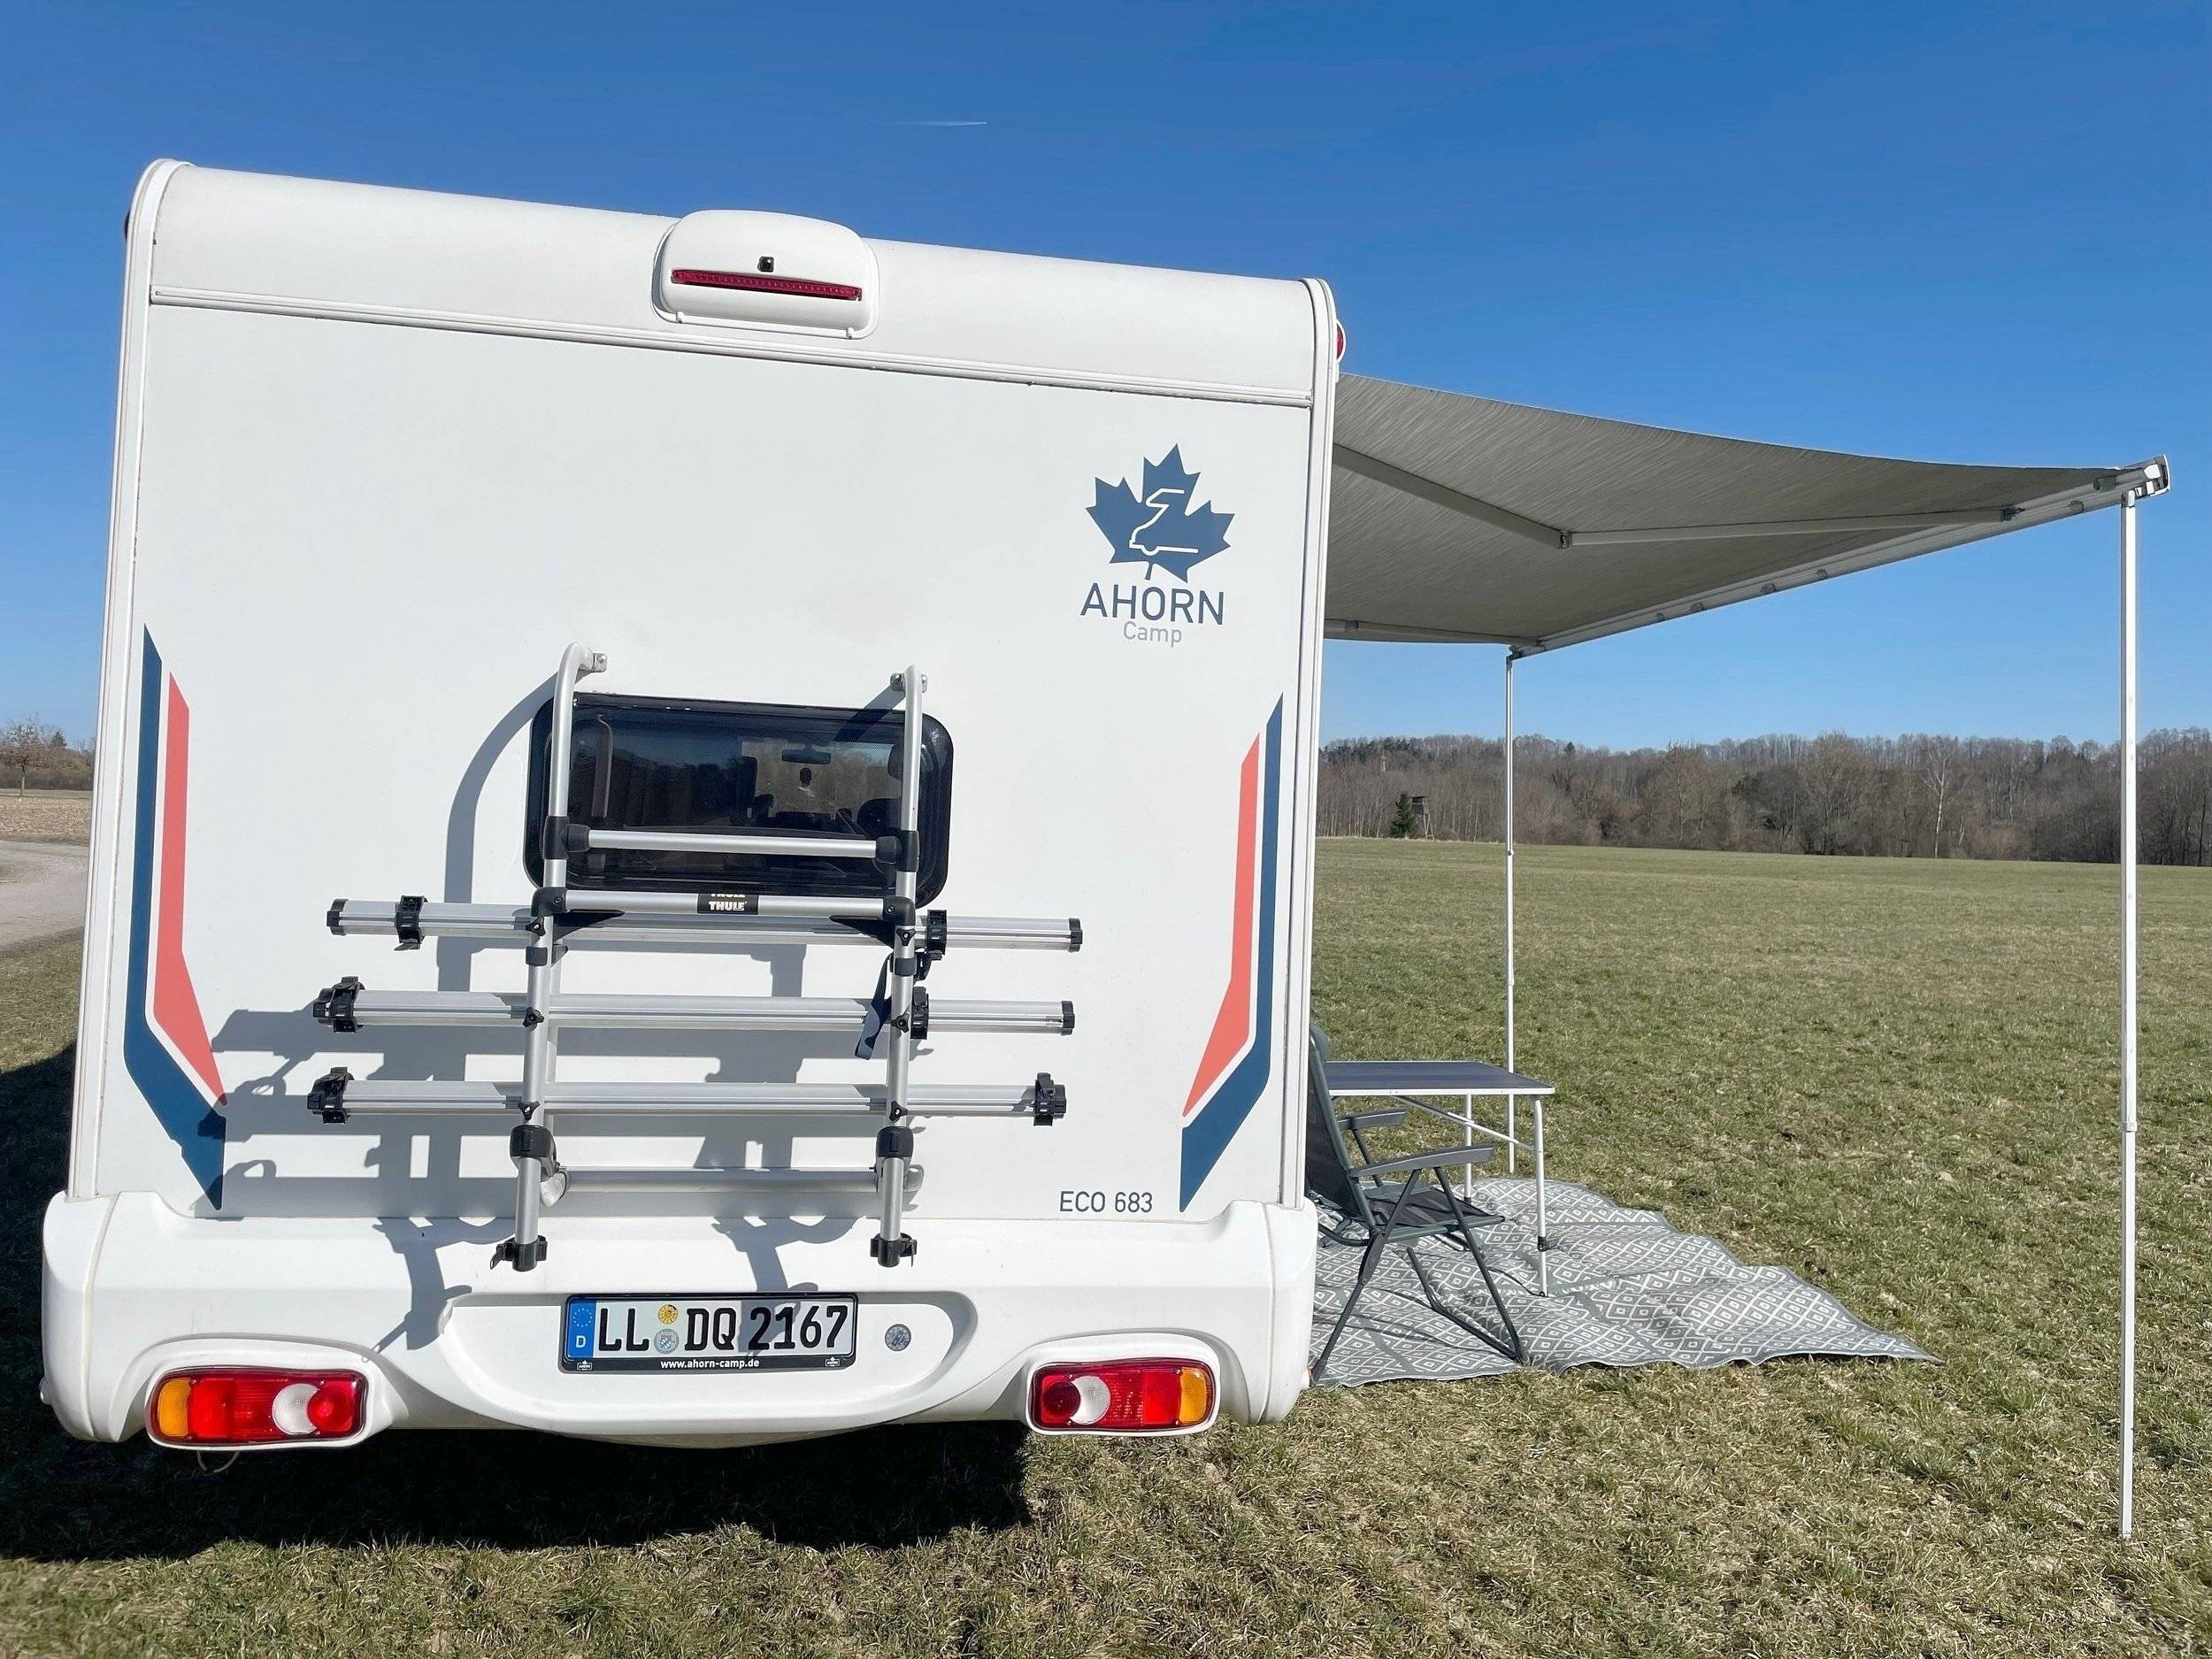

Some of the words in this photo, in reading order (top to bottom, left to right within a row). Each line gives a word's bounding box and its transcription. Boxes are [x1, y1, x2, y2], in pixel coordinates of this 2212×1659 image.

[1080, 582, 1224, 625] AHORN
[1123, 621, 1183, 648] Camp
[709, 901, 744, 911] THULE
[1059, 1190, 1106, 1212] ECO
[1114, 1191, 1153, 1213] 683
[599, 1308, 649, 1350] LL
[685, 1307, 737, 1350] DQ
[748, 1305, 849, 1350] 2167
[575, 1335, 587, 1348] D
[660, 1358, 760, 1369] www.ahorn-camp.de
